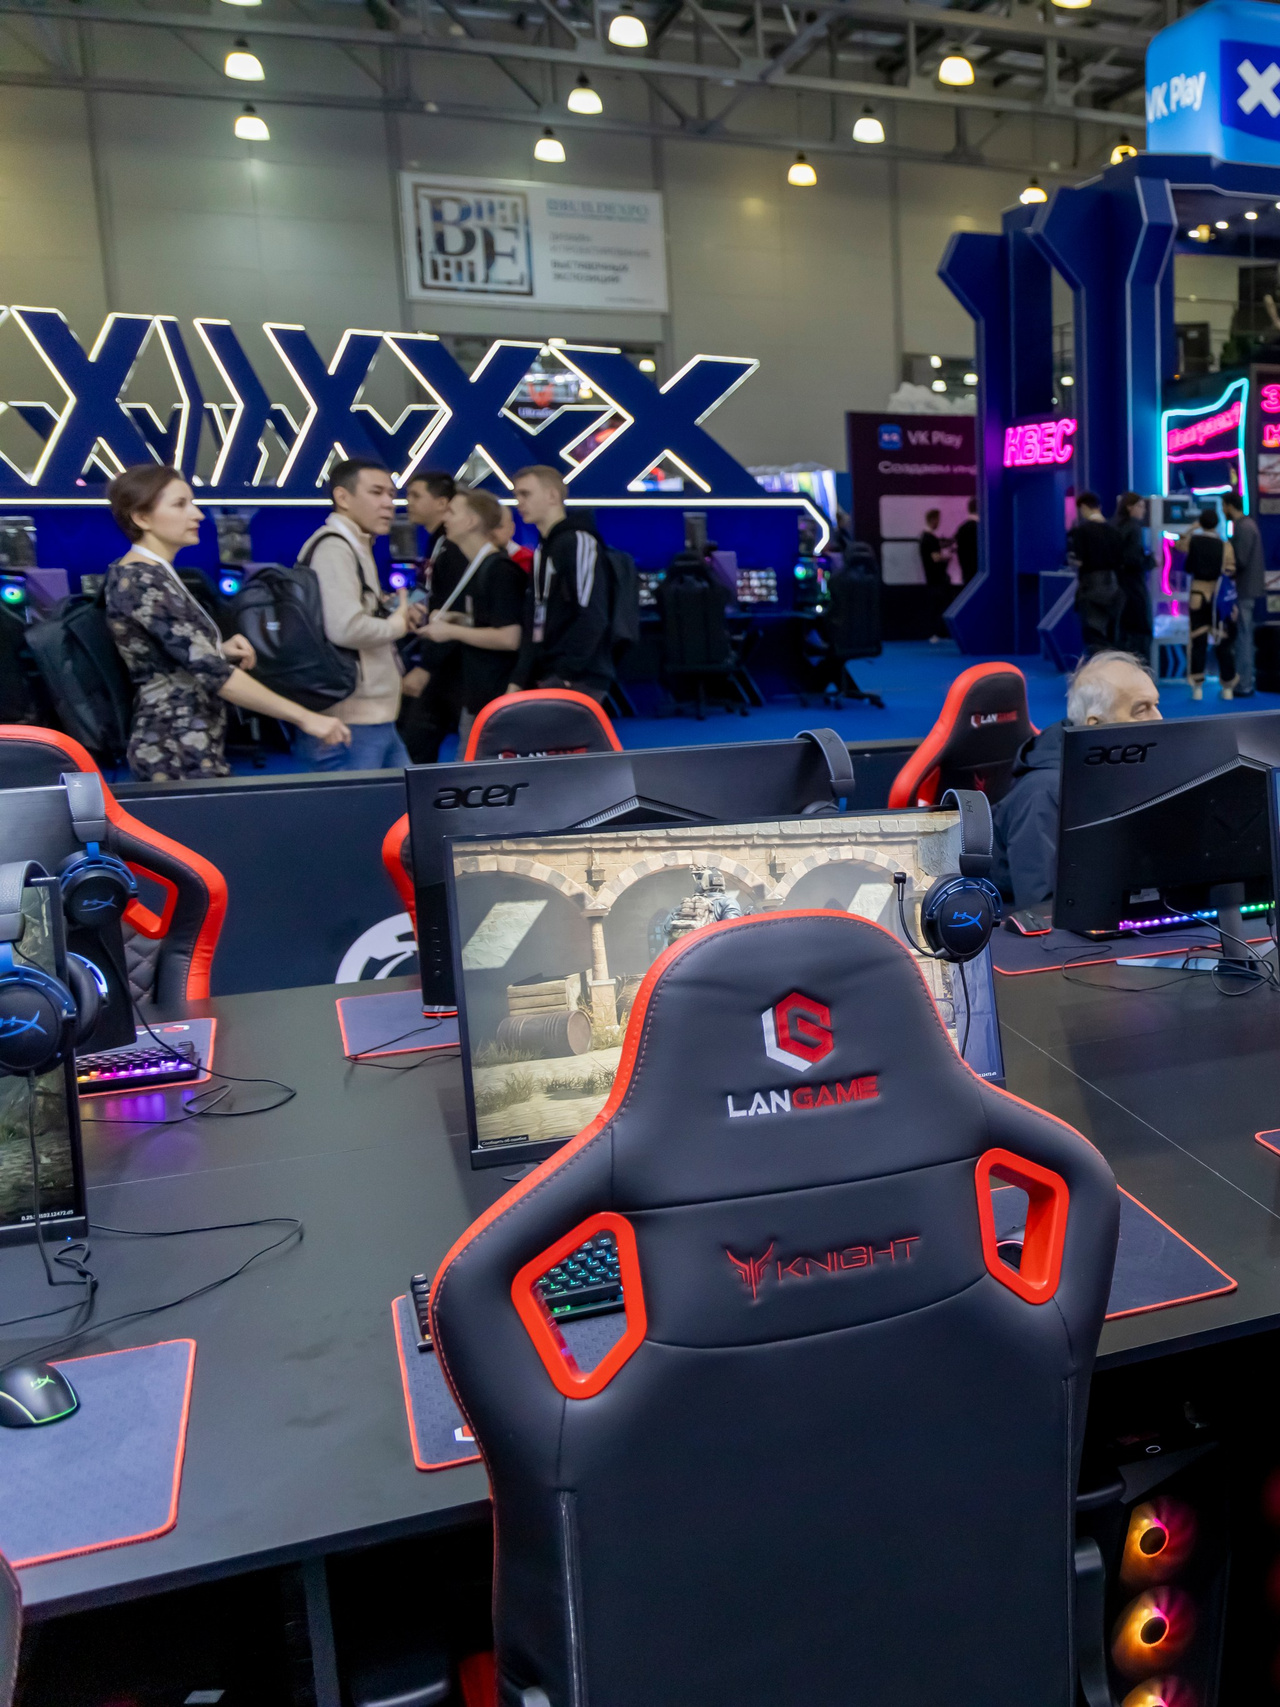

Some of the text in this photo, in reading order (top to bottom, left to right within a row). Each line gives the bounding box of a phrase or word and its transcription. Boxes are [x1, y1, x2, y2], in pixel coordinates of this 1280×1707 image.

[1147, 71, 1206, 124] VK Play
[907, 430, 963, 449] VK Play
[1083, 742, 1158, 766] acer
[433, 782, 530, 810] acer
[728, 1075, 880, 1118] LANGAME
[777, 1236, 921, 1282] KNIGHT
